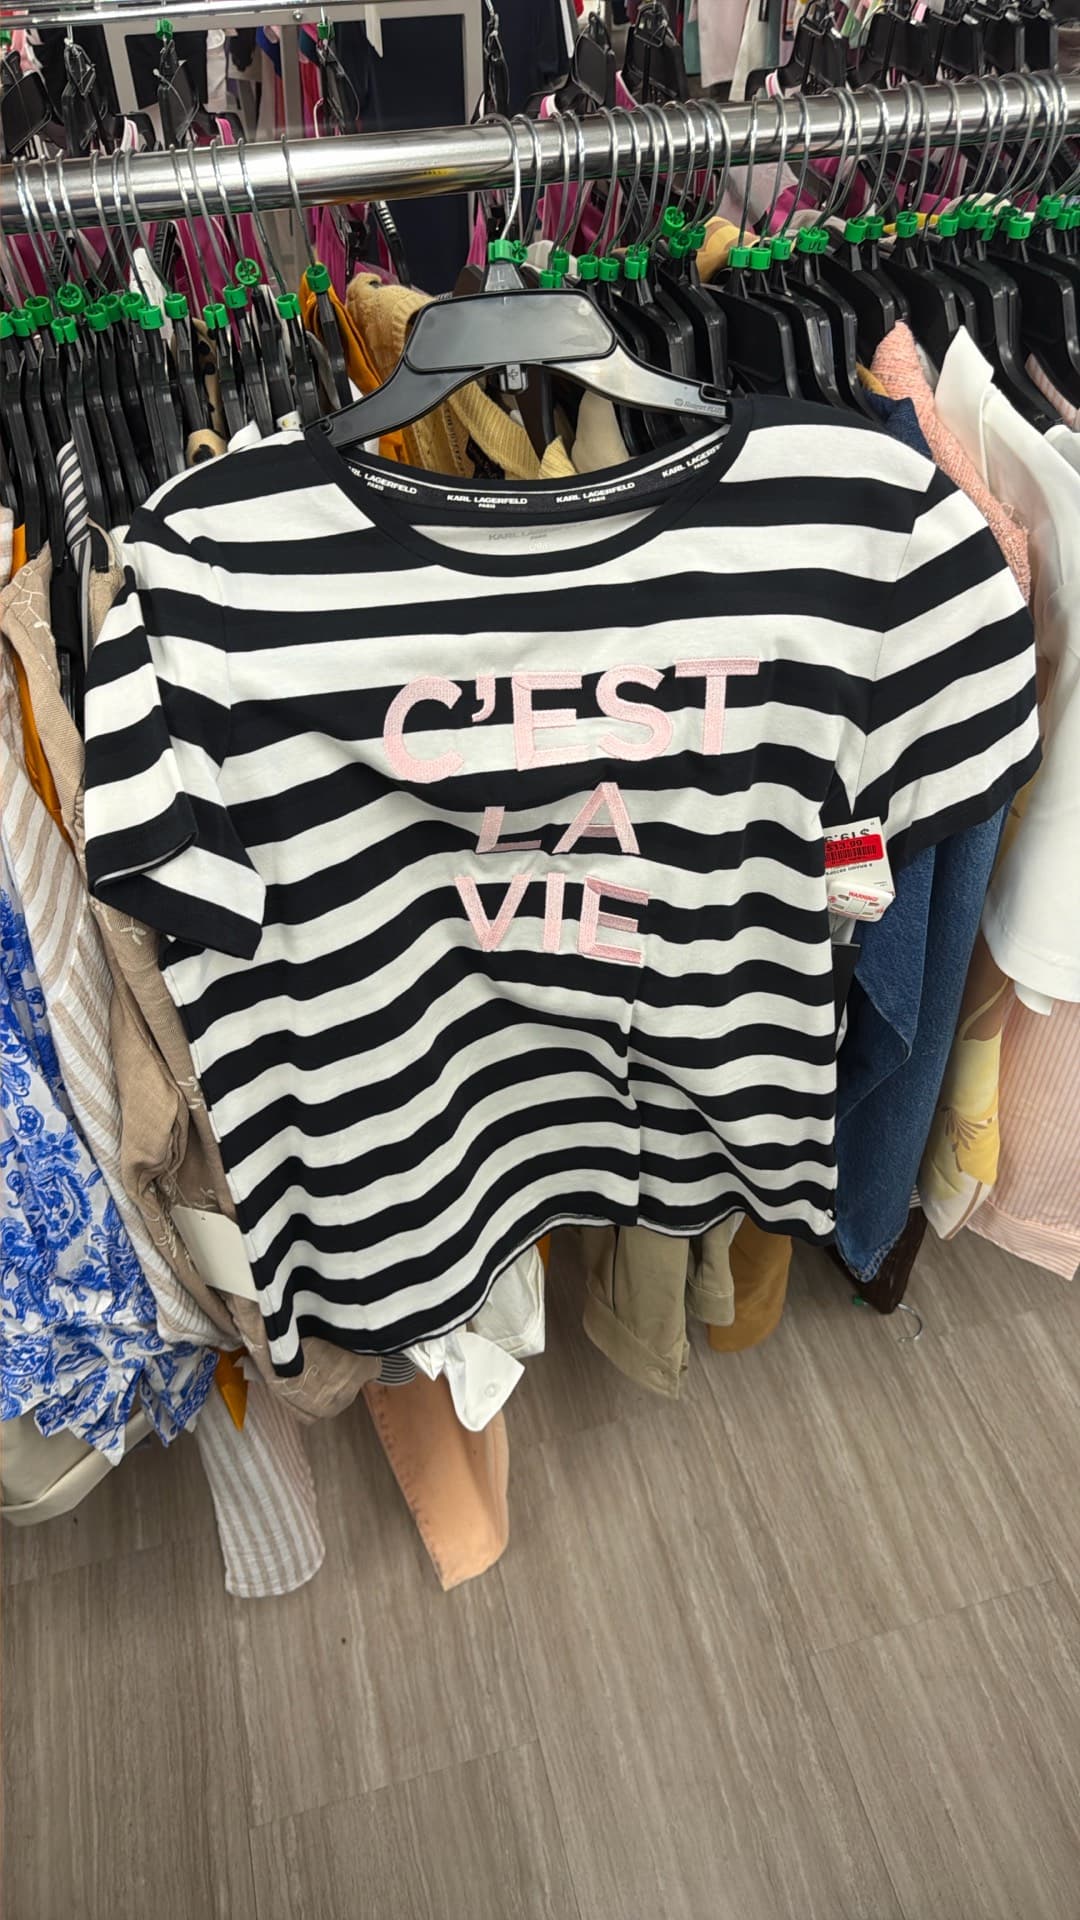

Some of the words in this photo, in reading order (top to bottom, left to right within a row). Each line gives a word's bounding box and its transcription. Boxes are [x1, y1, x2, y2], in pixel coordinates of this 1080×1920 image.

[662, 463, 686, 479] KARL
[364, 473, 418, 495] LAGERFELD
[556, 493, 582, 504] KARL
[582, 481, 636, 500] LAGERFELD
[446, 494, 472, 503] KARL
[474, 497, 528, 505] LAGERFELD
[475, 781, 641, 856] LA
[454, 872, 649, 968] VIE
